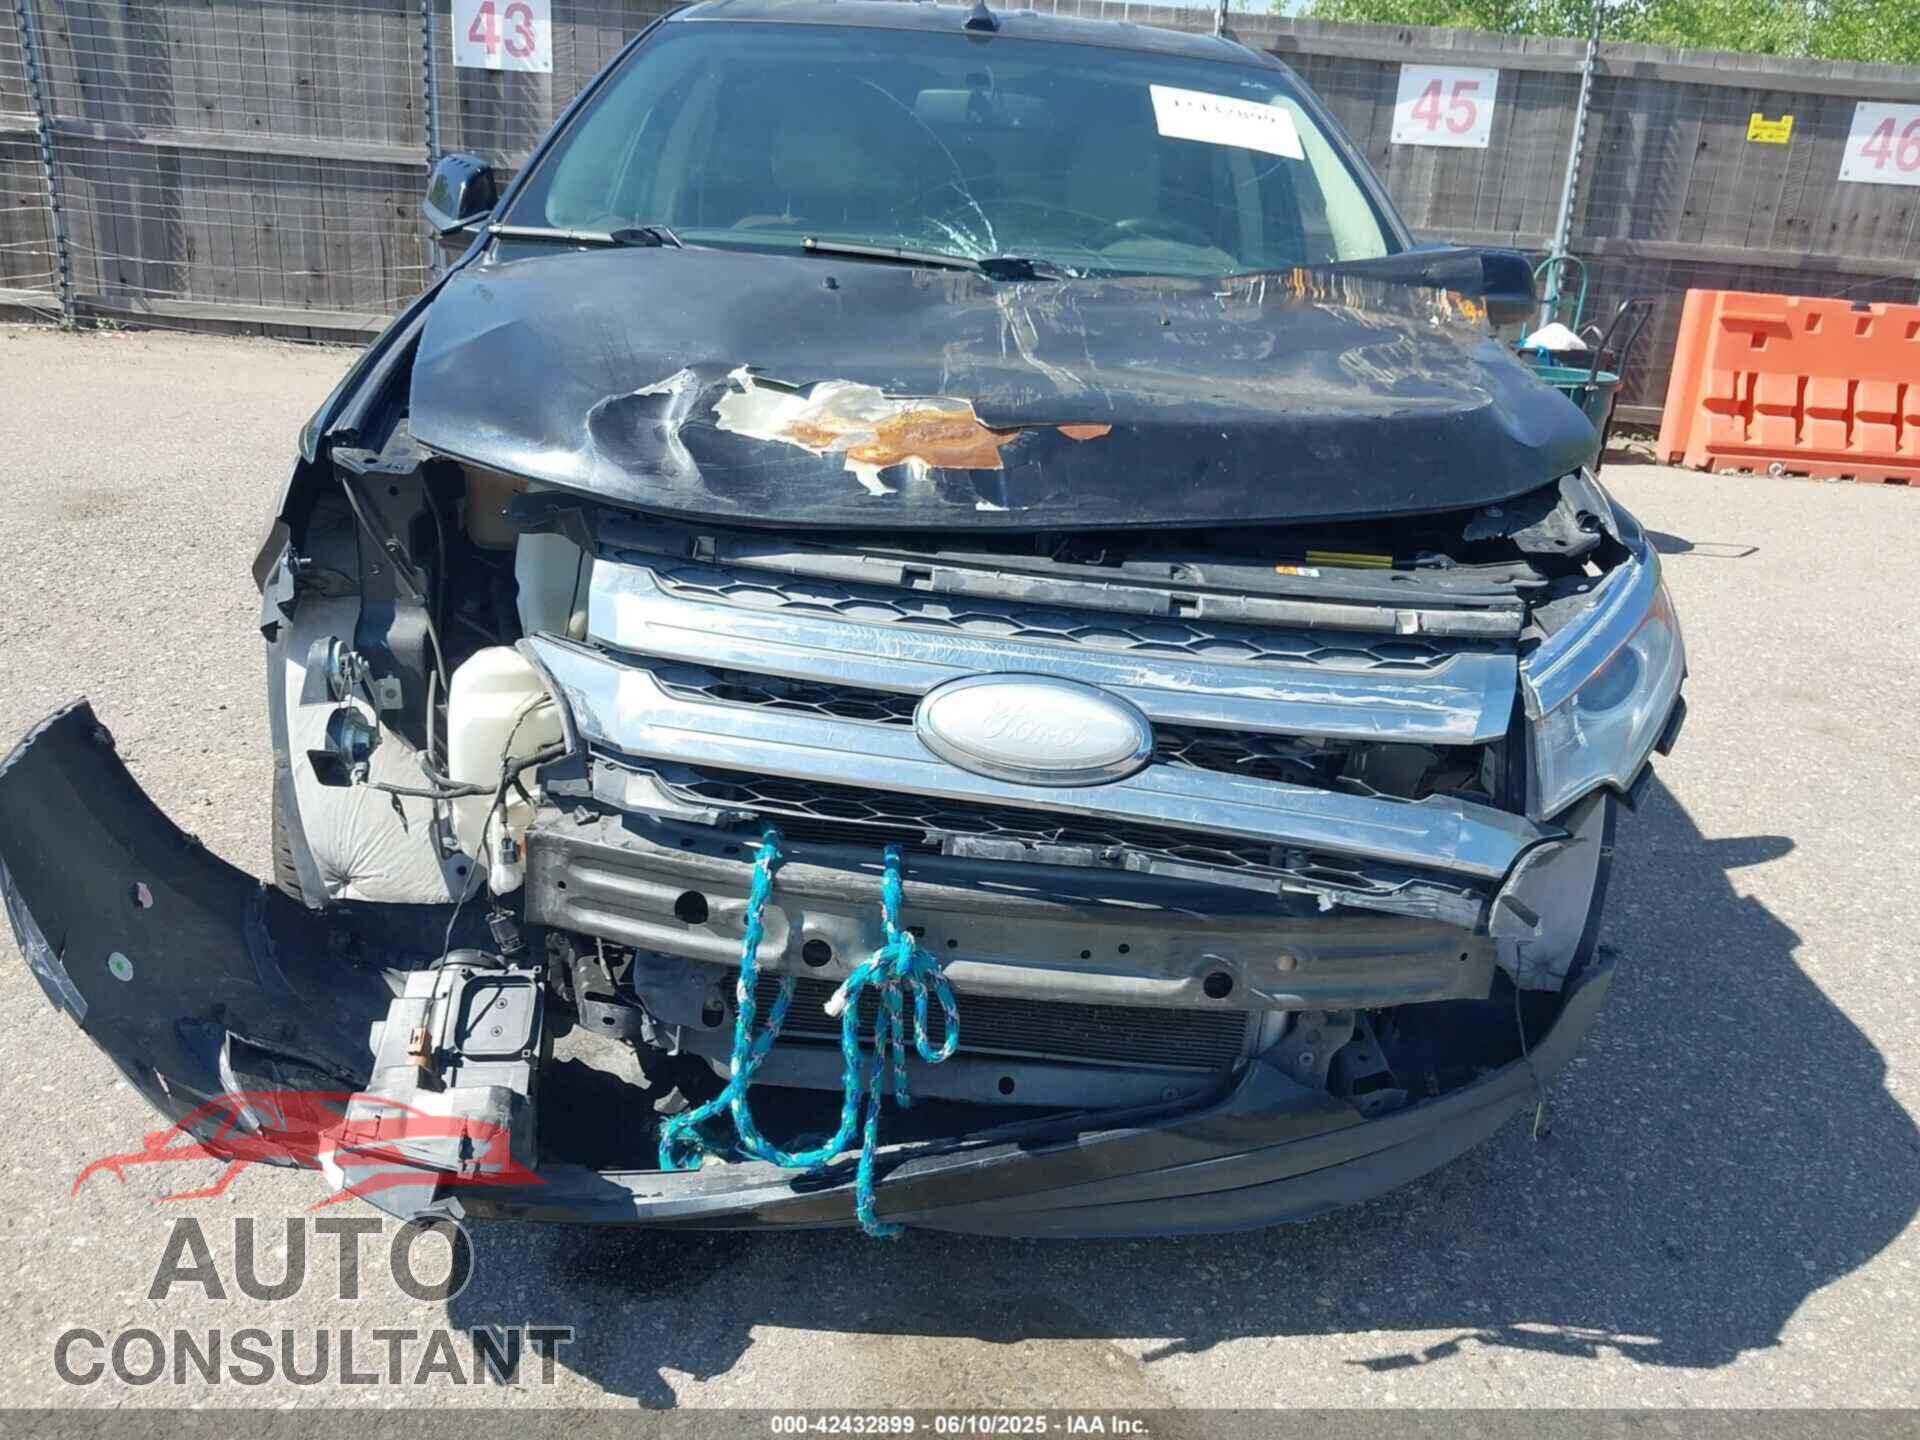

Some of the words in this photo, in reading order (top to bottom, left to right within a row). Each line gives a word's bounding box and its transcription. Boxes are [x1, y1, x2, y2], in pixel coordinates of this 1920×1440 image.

[468, 1, 535, 58] 43
[1411, 80, 1480, 134] 45
[1861, 117, 1920, 172] 46
